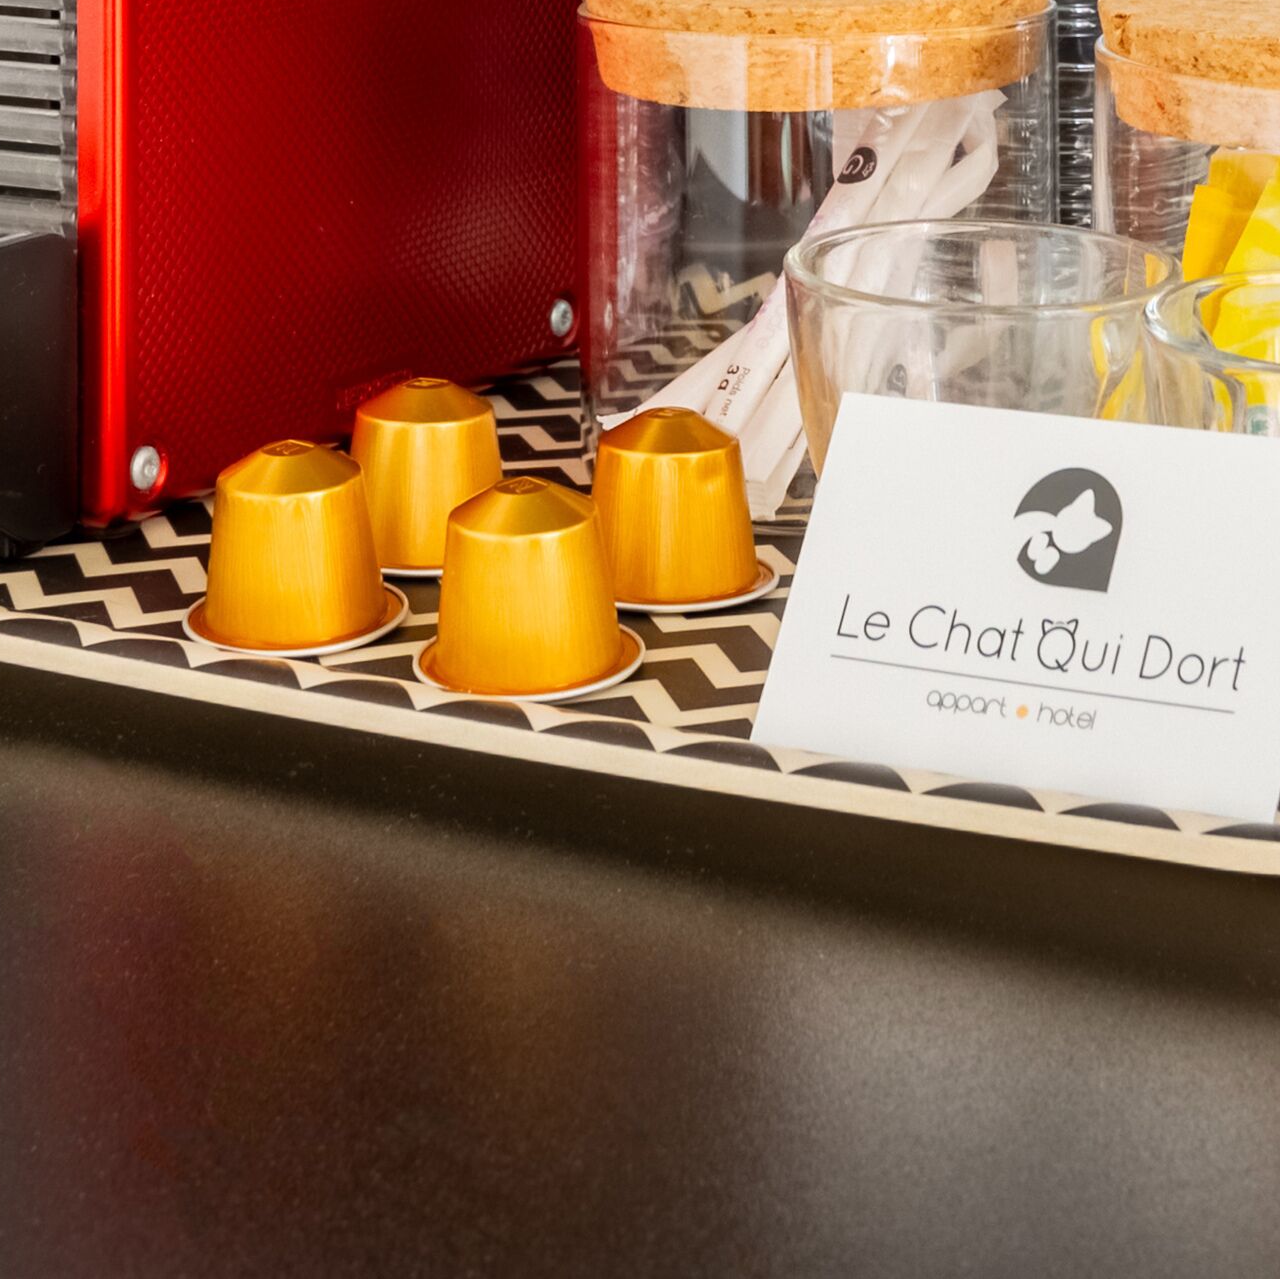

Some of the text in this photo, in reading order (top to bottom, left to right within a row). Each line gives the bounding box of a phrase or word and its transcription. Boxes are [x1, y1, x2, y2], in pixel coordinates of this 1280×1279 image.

[836, 594, 1248, 692] Le Chat Qui Dort
[925, 688, 1098, 731] appart hotel
